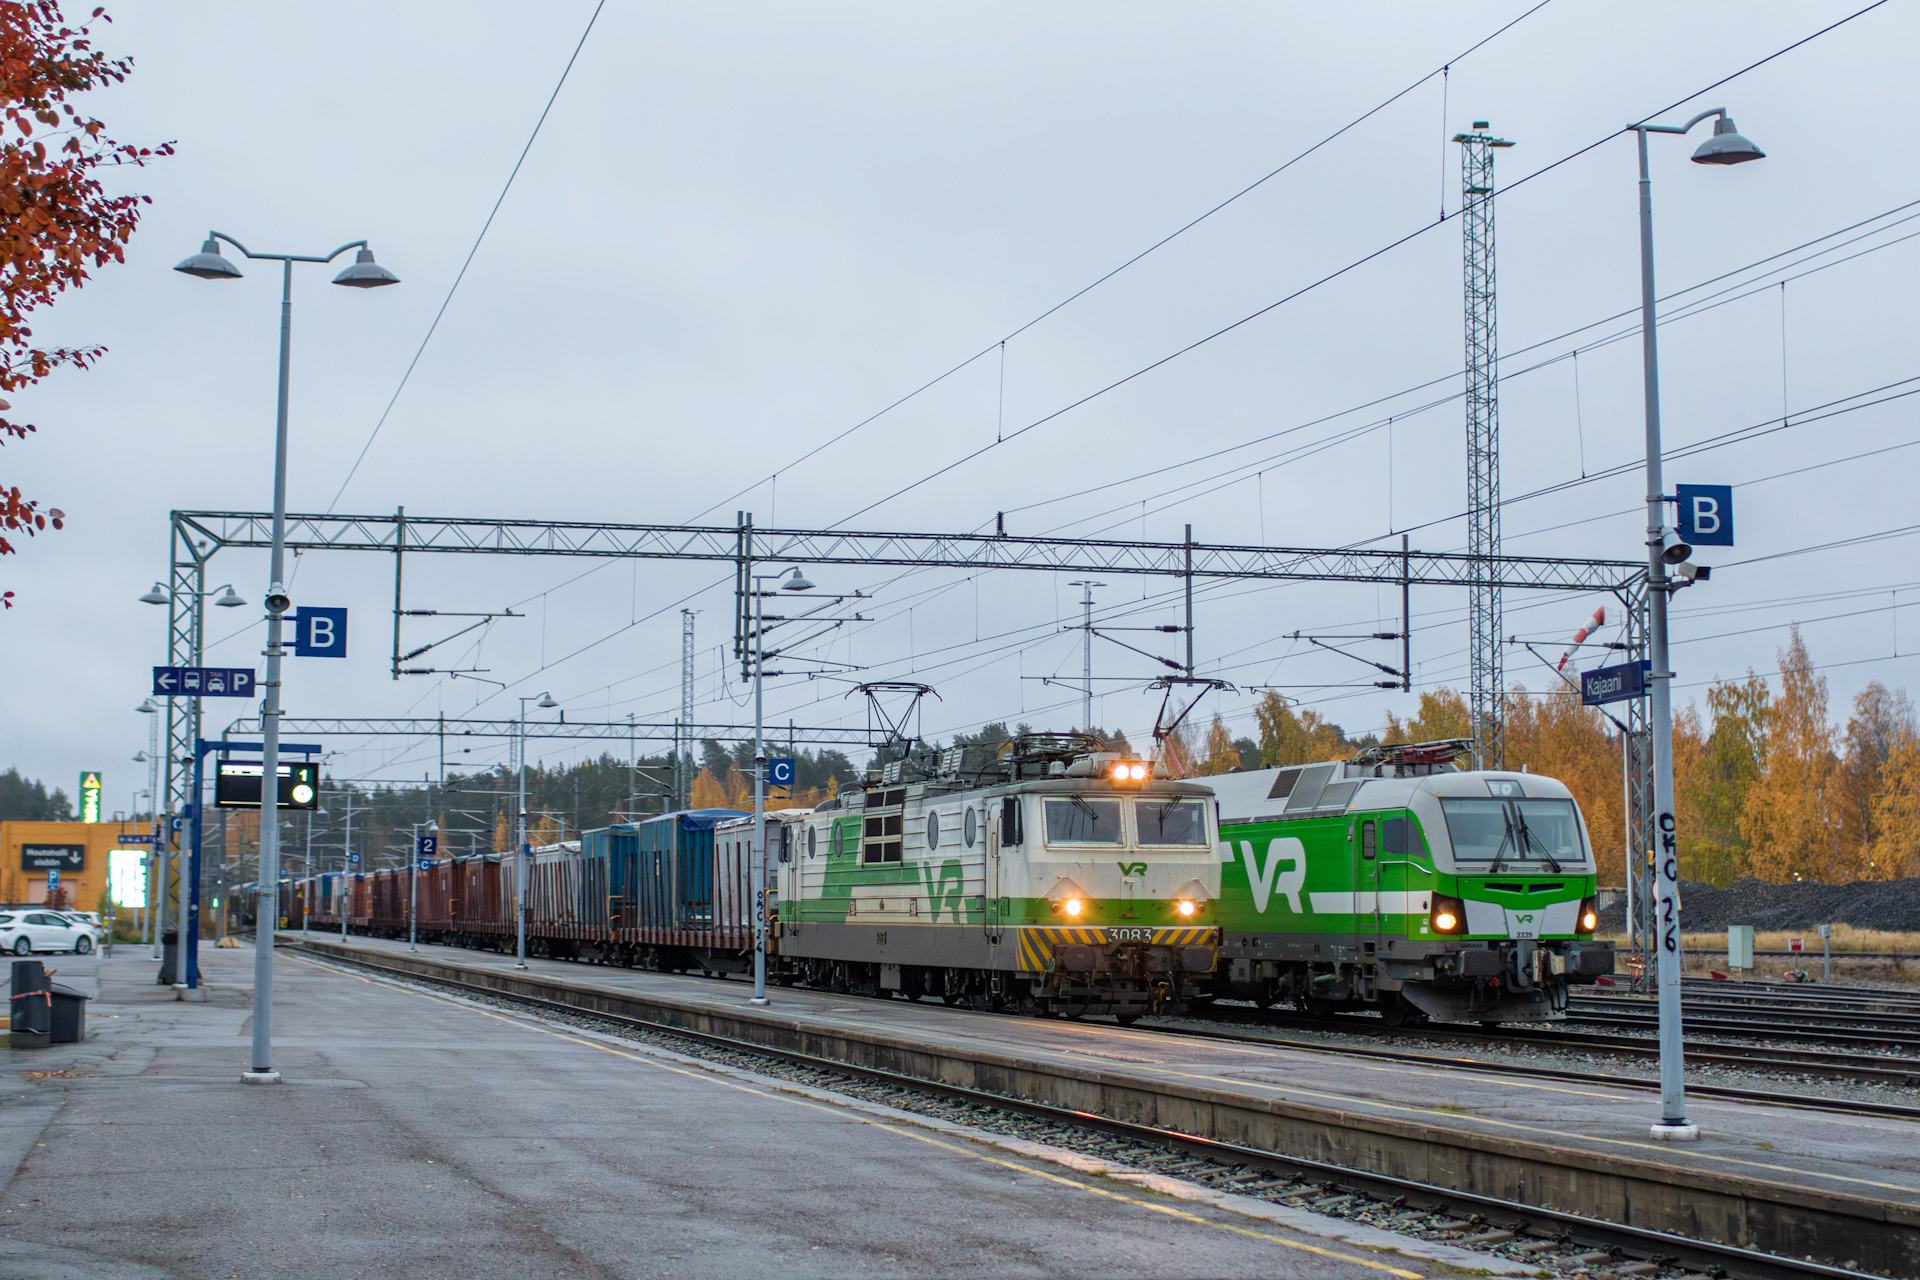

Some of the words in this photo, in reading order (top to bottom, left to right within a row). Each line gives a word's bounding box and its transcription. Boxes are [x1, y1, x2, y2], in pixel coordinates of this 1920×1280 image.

[1692, 496, 1720, 534] B
[310, 617, 335, 648] B
[233, 673, 249, 691] P
[1586, 672, 1621, 699] Kajaani
[299, 769, 307, 782] 1
[775, 763, 789, 780] C
[423, 838, 433, 852] 2
[352, 854, 359, 862] D
[421, 860, 429, 869] C
[1117, 861, 1148, 876] VR
[1239, 837, 1306, 914] VR
[49, 871, 57, 883] P
[923, 858, 963, 923] VR
[1515, 914, 1533, 924] VR
[1662, 897, 1676, 953] 26
[1108, 928, 1152, 943] 3083
[1516, 931, 1533, 939] 3339
